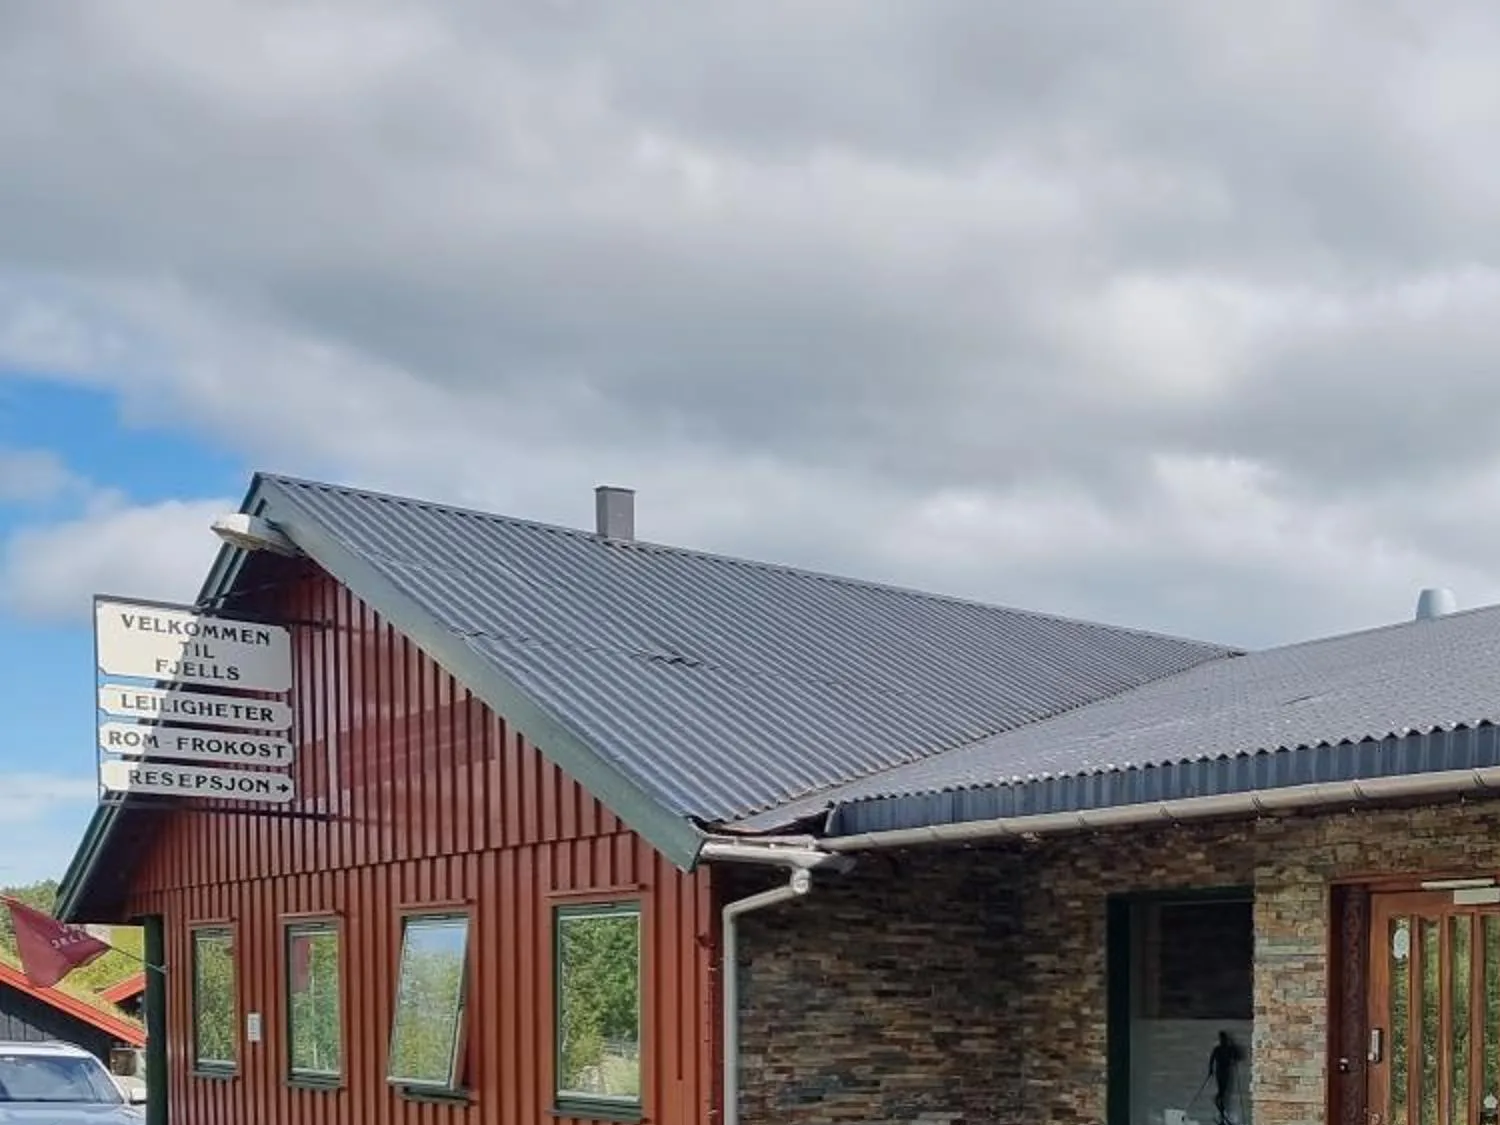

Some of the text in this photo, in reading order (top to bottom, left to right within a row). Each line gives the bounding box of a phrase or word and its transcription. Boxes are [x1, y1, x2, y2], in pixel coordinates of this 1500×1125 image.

[121, 613, 271, 646] VELKOMMEN
[180, 641, 216, 659] TIL
[155, 659, 241, 682] FJELLS
[121, 694, 274, 723] LEILIGHETER
[108, 731, 159, 749] ROM
[177, 736, 287, 759] FROKOST
[129, 769, 270, 793] RESEPSJON
